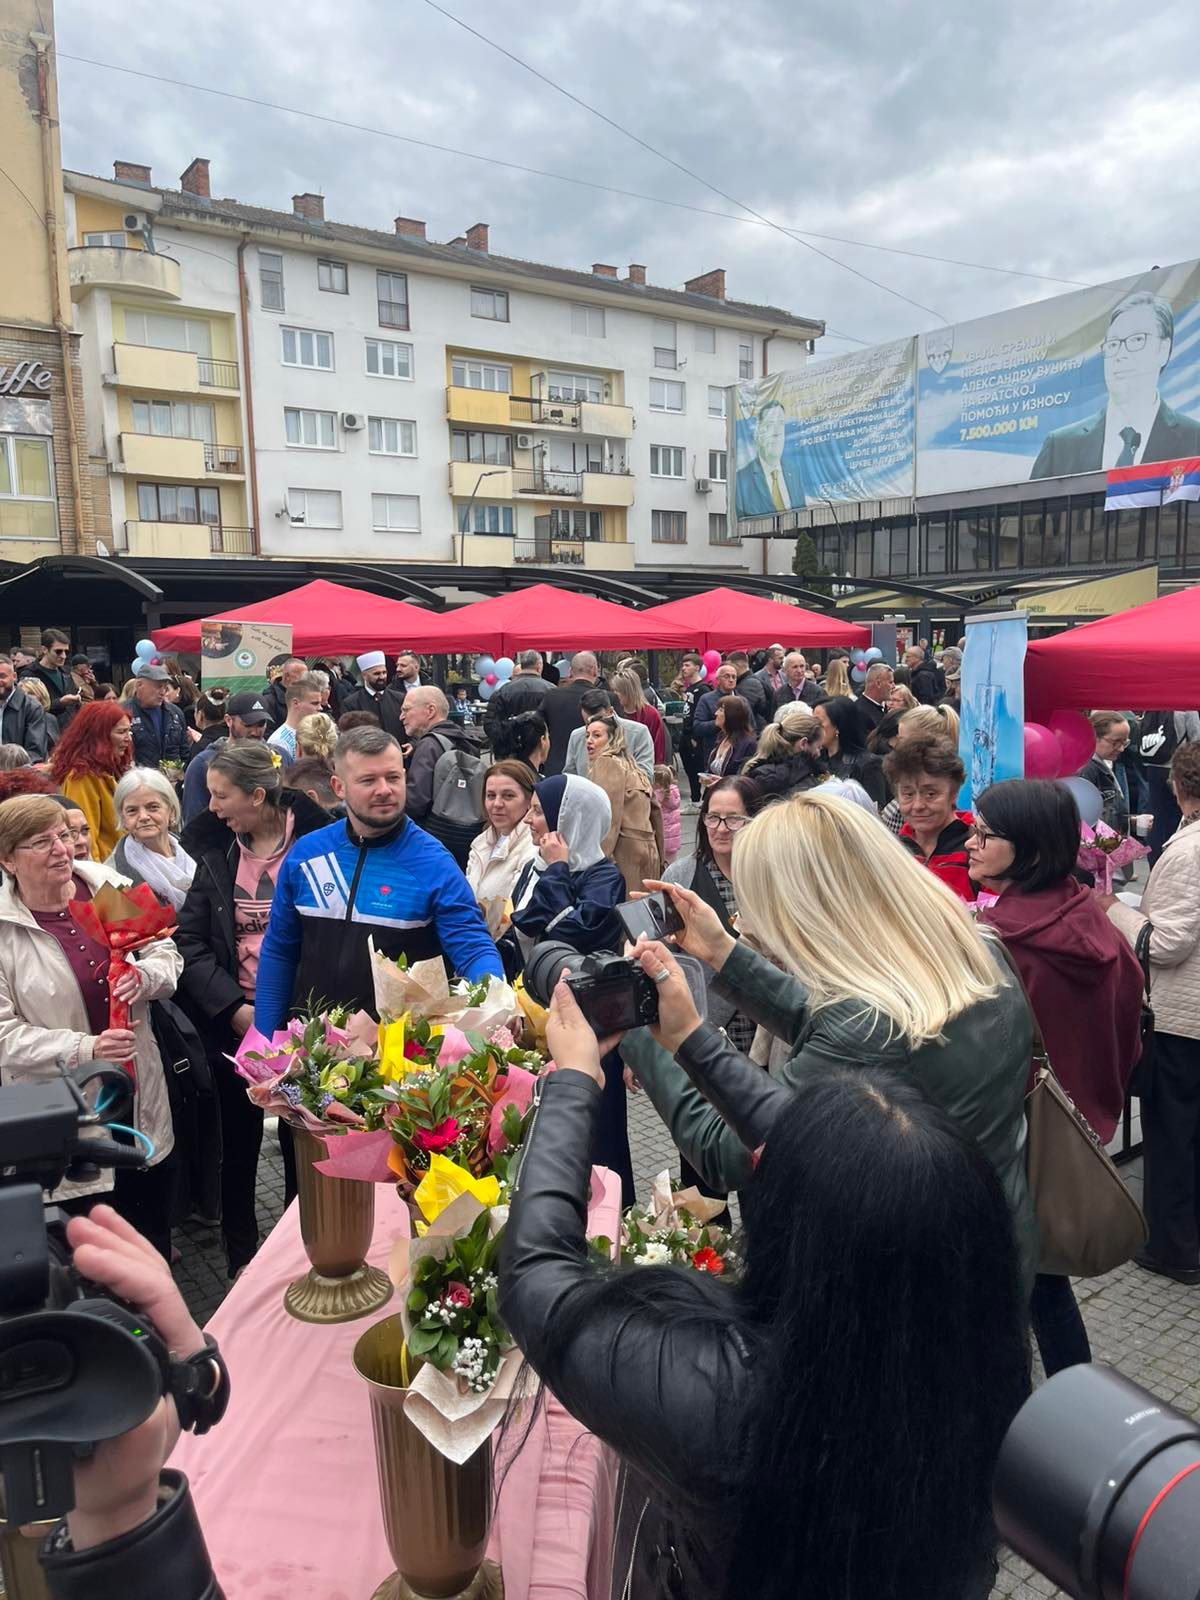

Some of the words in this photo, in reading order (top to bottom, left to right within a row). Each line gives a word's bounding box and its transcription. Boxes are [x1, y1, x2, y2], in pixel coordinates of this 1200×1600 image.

[960, 368, 1034, 394] АЛЕКСАНДРУ
[977, 384, 1037, 406] БРАТСКОЈ
[960, 405, 1010, 423] ПОМОЋИ
[1012, 401, 1021, 413] У
[1022, 391, 1071, 411] ИЗНОСУ
[959, 420, 1018, 441] 7.500.000
[844, 448, 871, 460] ШКОЛЕ
